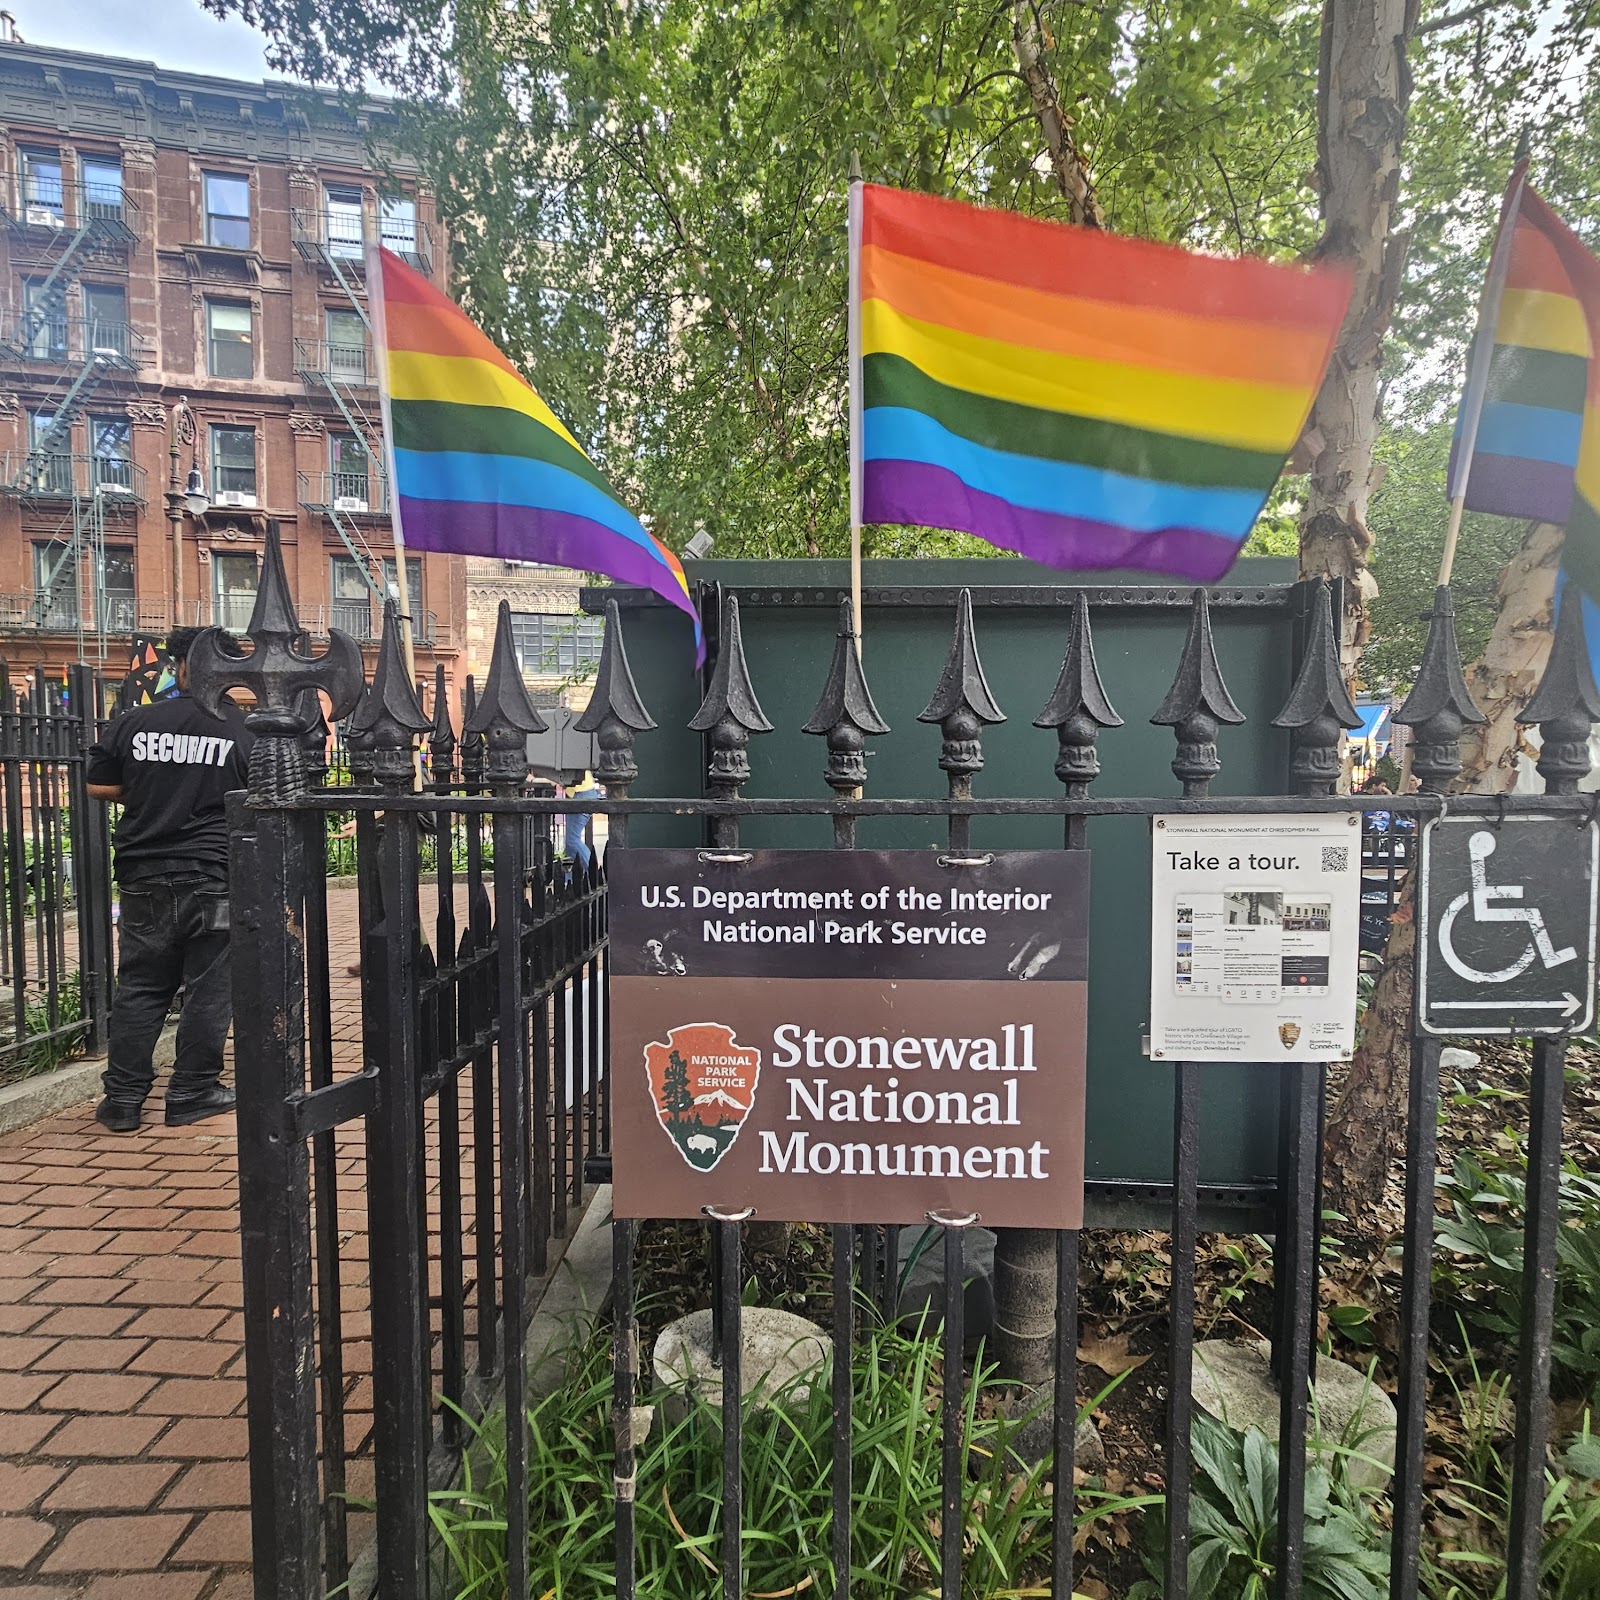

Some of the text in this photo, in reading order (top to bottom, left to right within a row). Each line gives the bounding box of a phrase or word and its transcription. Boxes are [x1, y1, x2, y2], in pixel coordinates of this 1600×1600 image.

[132, 732, 235, 767] SECURITY
[1166, 850, 1301, 871] Take a tour.
[641, 886, 1053, 912] U.S. Department of the Interior
[702, 920, 987, 945] National Park Service
[772, 1023, 1038, 1072] Stonewall
[1309, 1043, 1342, 1051] Connects
[691, 1055, 752, 1066] NATIONAL
[705, 1066, 738, 1077] PARK
[697, 1077, 746, 1088] SERVICE
[785, 1077, 1021, 1125] National
[758, 1130, 1050, 1179] Monument
